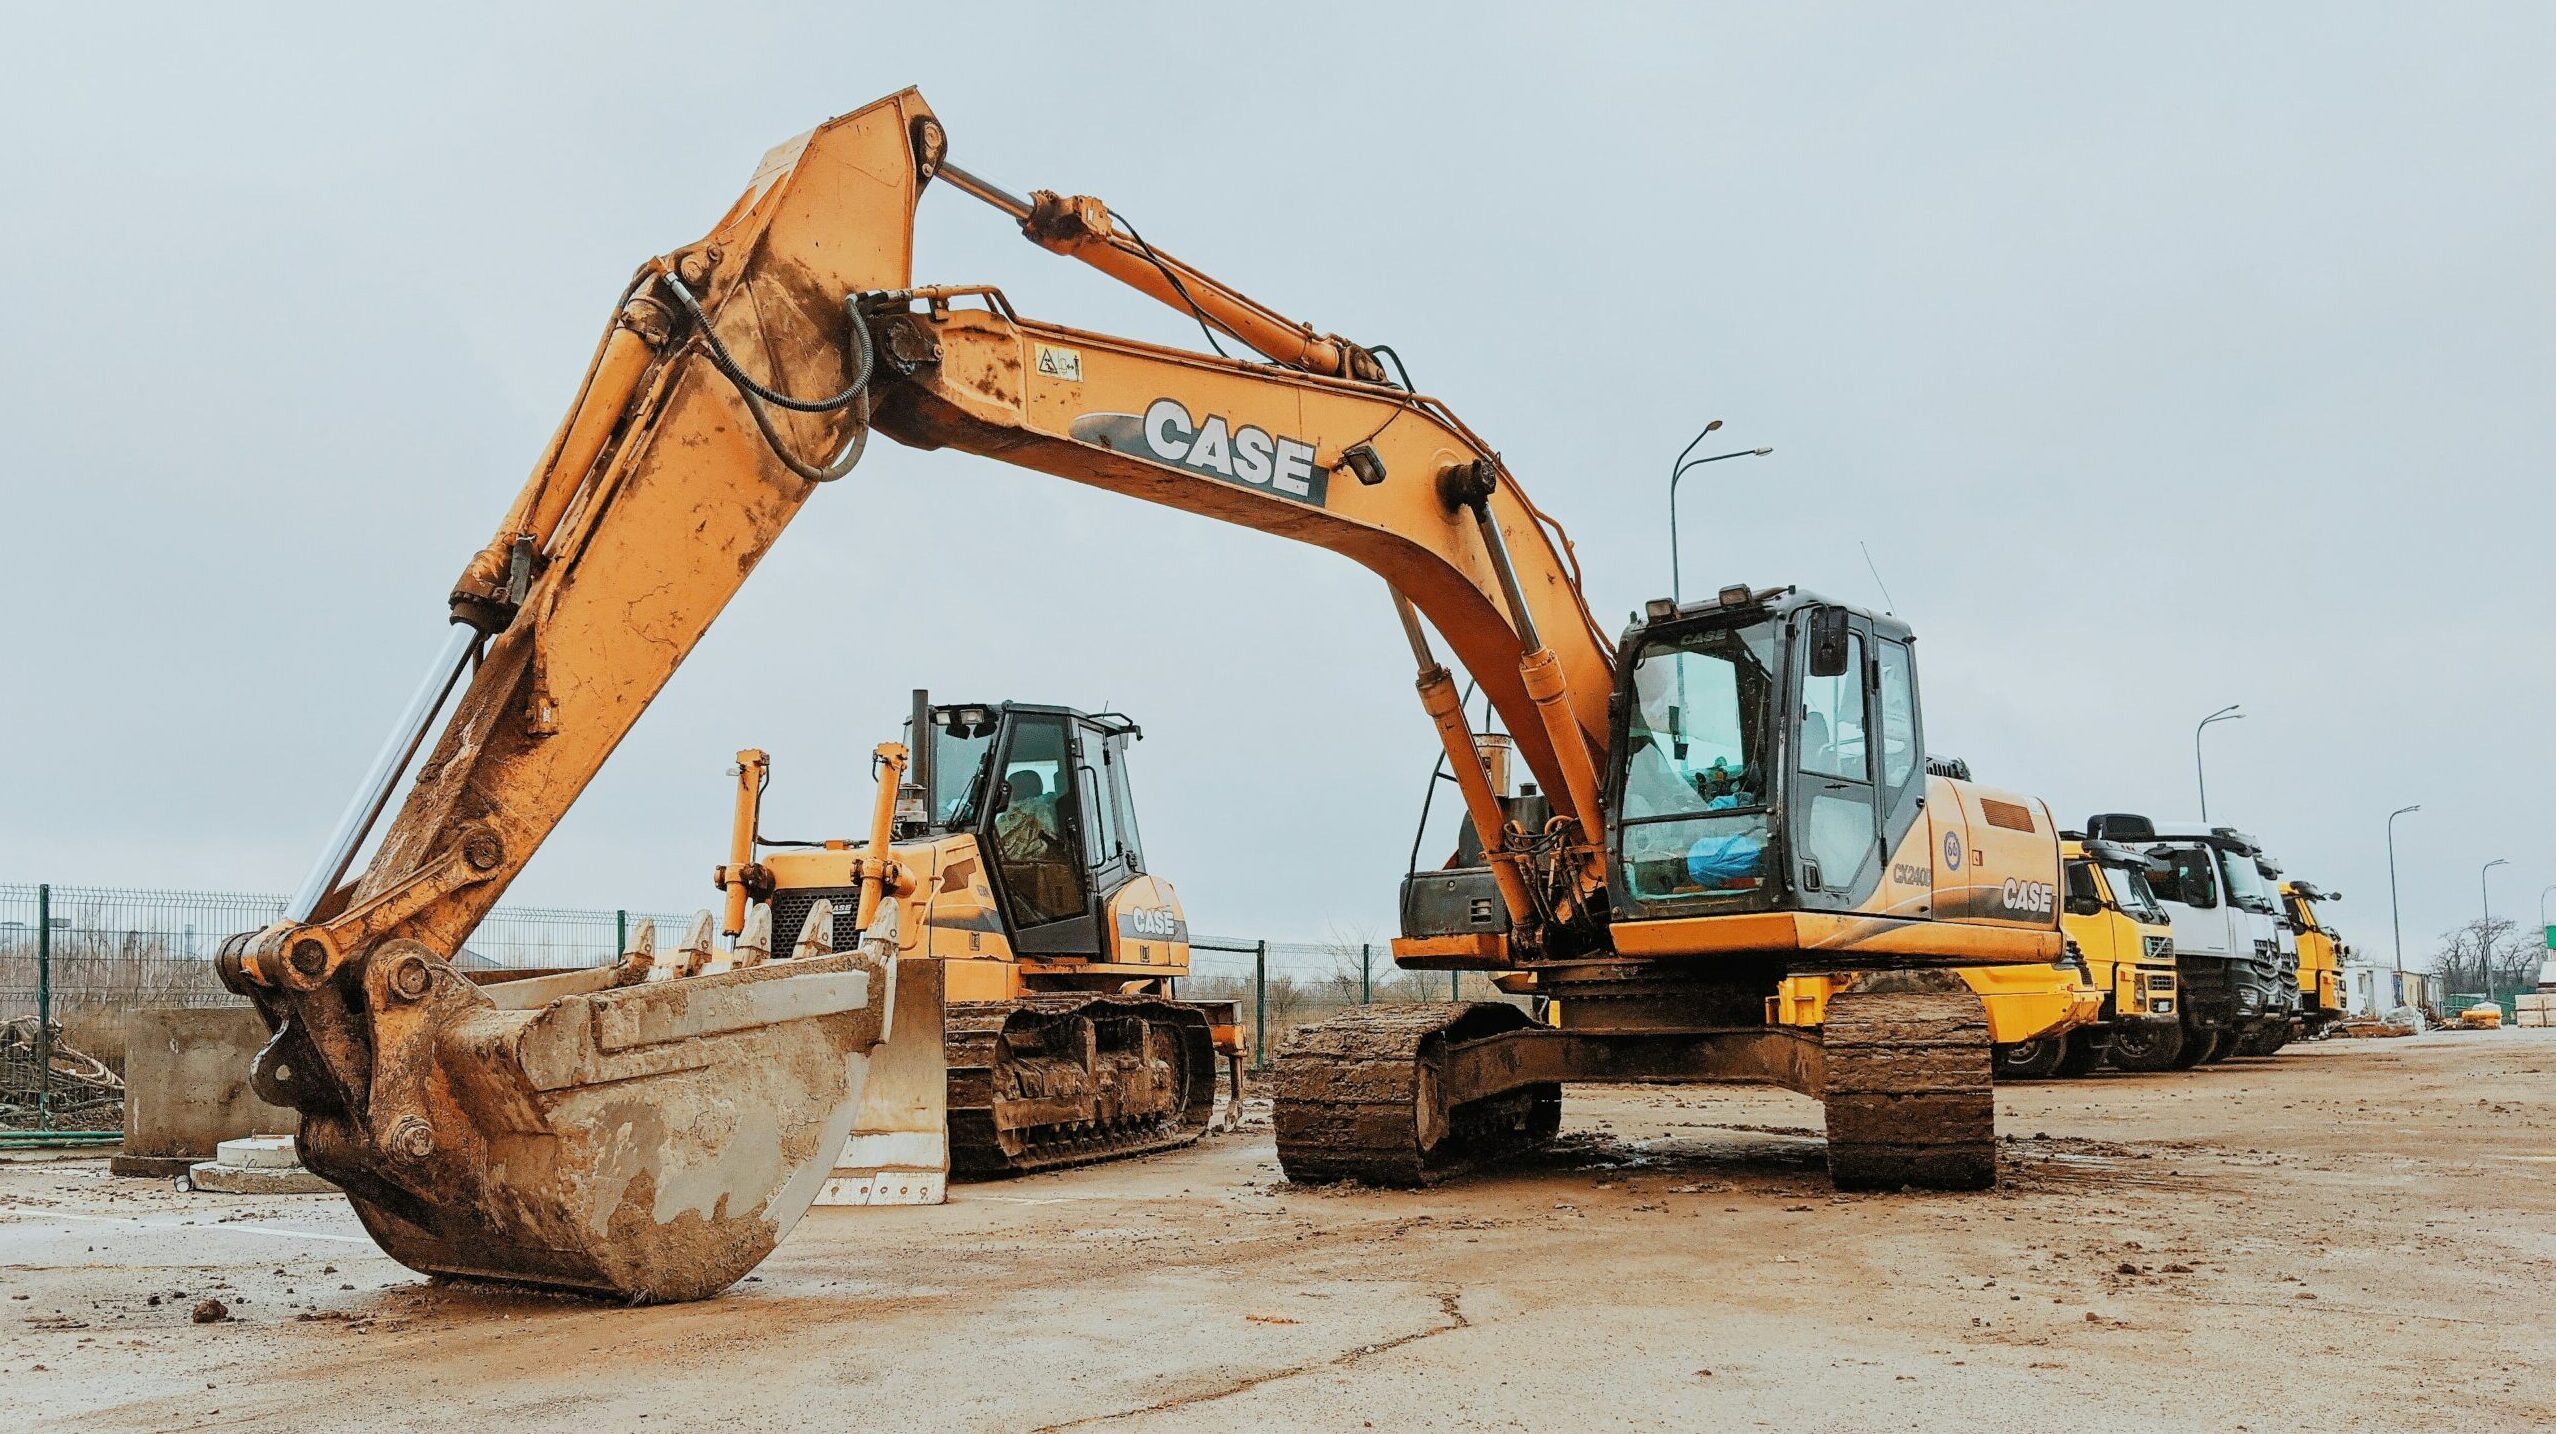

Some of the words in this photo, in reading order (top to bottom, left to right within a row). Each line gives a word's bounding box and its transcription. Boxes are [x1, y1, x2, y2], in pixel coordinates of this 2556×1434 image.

[1144, 398, 1315, 498] CASE
[1681, 629, 1727, 645] CASE
[2002, 877, 2053, 912] CASE
[1132, 906, 1175, 935] CASE
